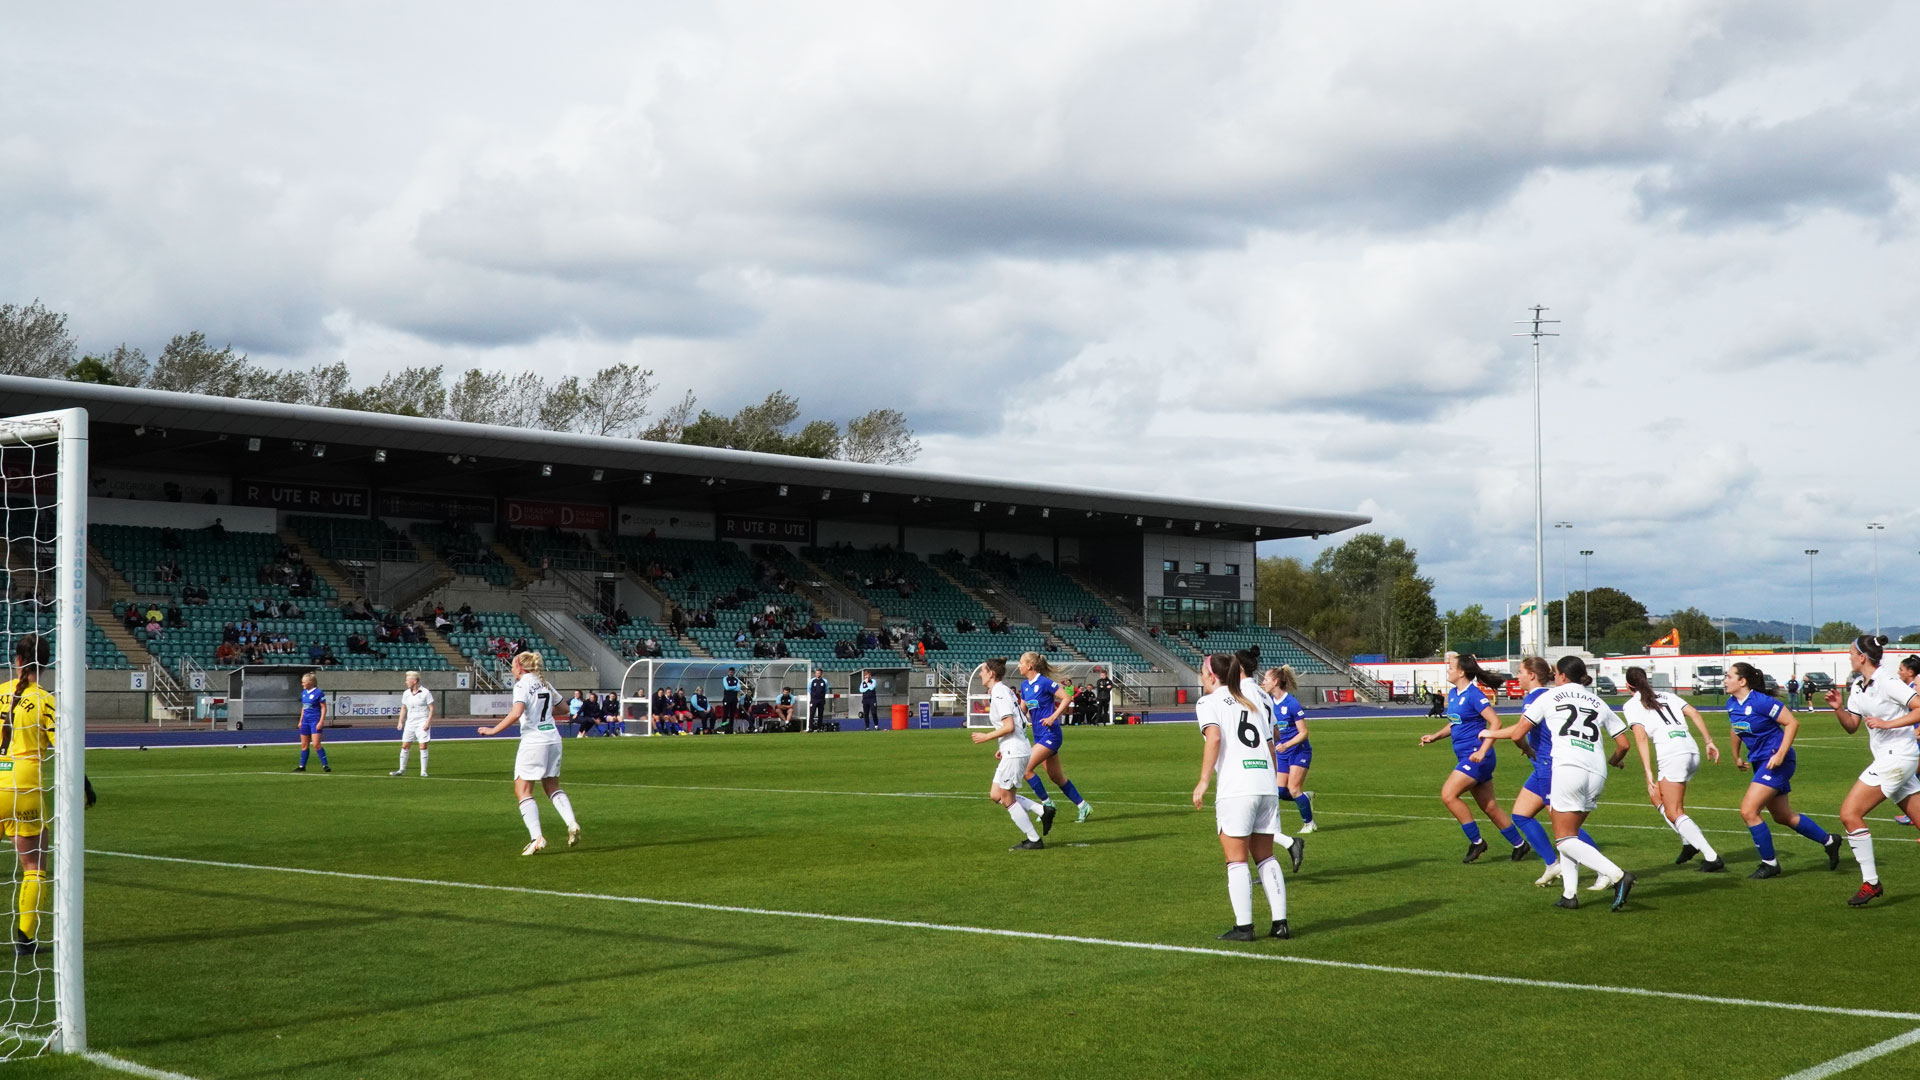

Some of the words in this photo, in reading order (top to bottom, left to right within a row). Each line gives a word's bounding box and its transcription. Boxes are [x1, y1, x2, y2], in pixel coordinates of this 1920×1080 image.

[135, 678, 142, 688] 3
[194, 678, 202, 688] 3
[460, 677, 466, 688] 4
[537, 692, 550, 722] 7
[1553, 691, 1601, 709] WILLIAMS
[352, 707, 379, 715] HOUSE
[380, 707, 392, 715] OF
[1654, 702, 1682, 726] 11
[1237, 710, 1260, 749] 6
[1555, 703, 1599, 743] 23
